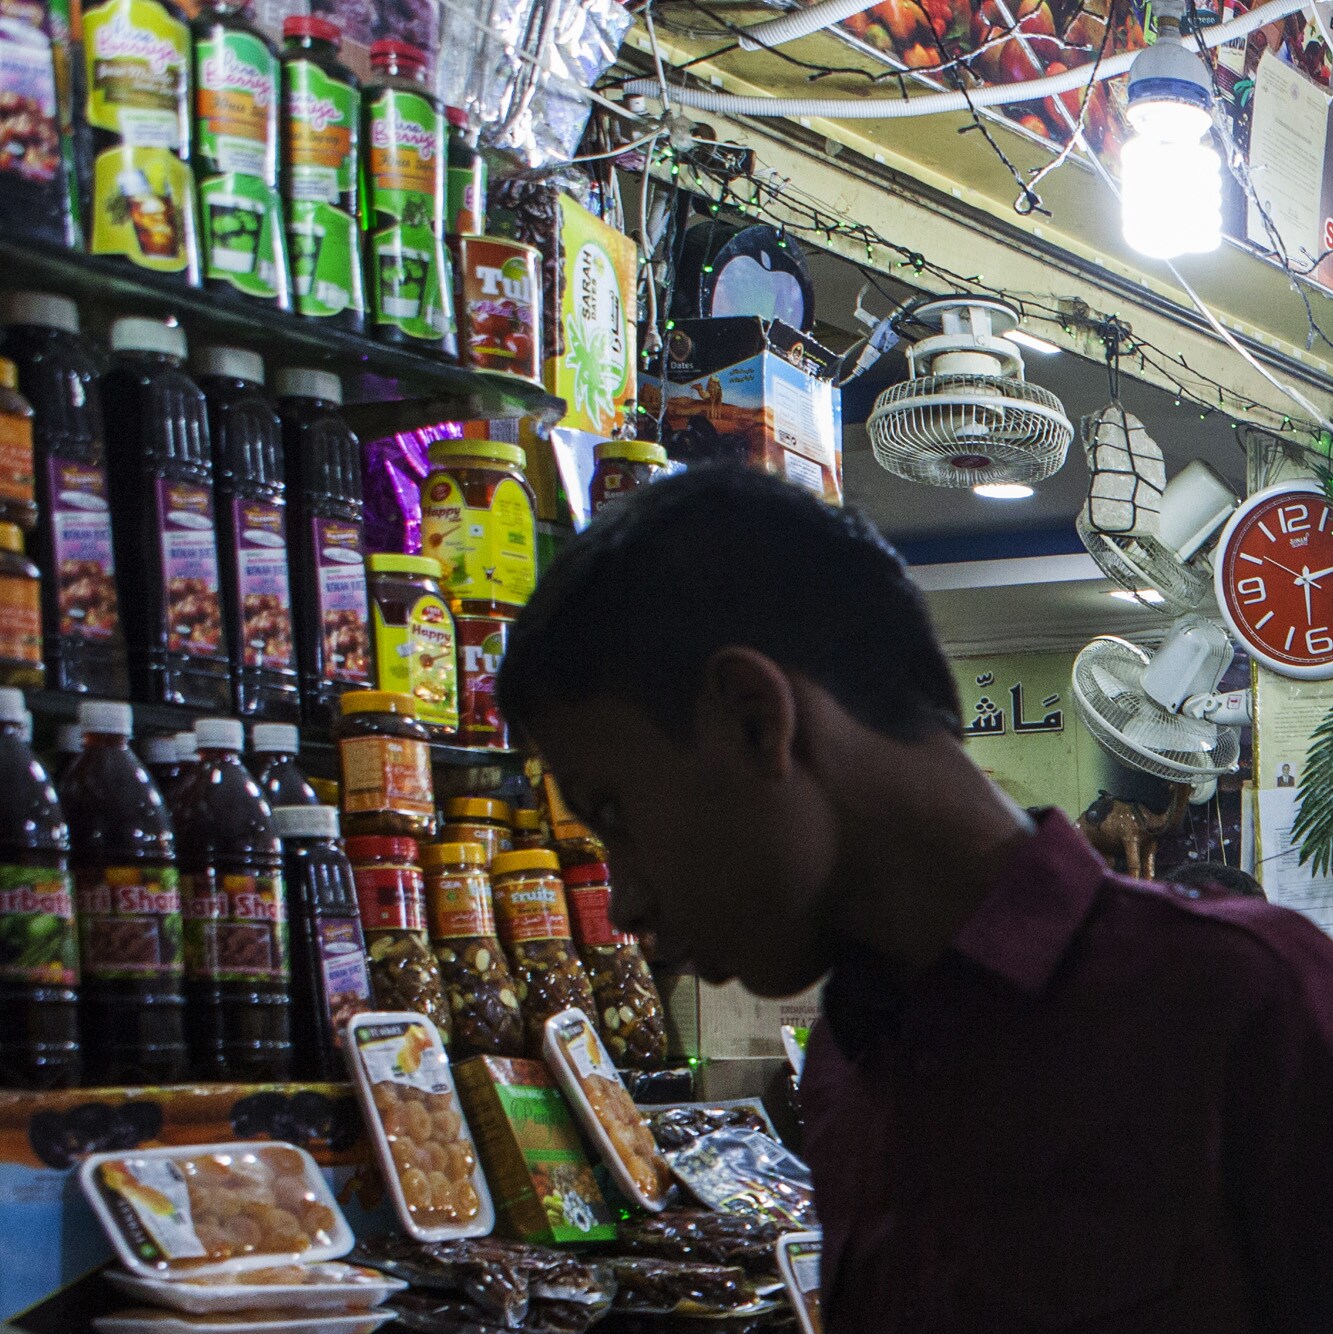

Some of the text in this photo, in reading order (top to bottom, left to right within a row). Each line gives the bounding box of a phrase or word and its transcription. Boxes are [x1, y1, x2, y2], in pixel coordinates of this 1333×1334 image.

[581, 250, 593, 321] SARAH
[670, 361, 694, 370] Dates
[1278, 504, 1311, 534] 12
[1238, 577, 1266, 605] 9
[1304, 626, 1333, 655] 6
